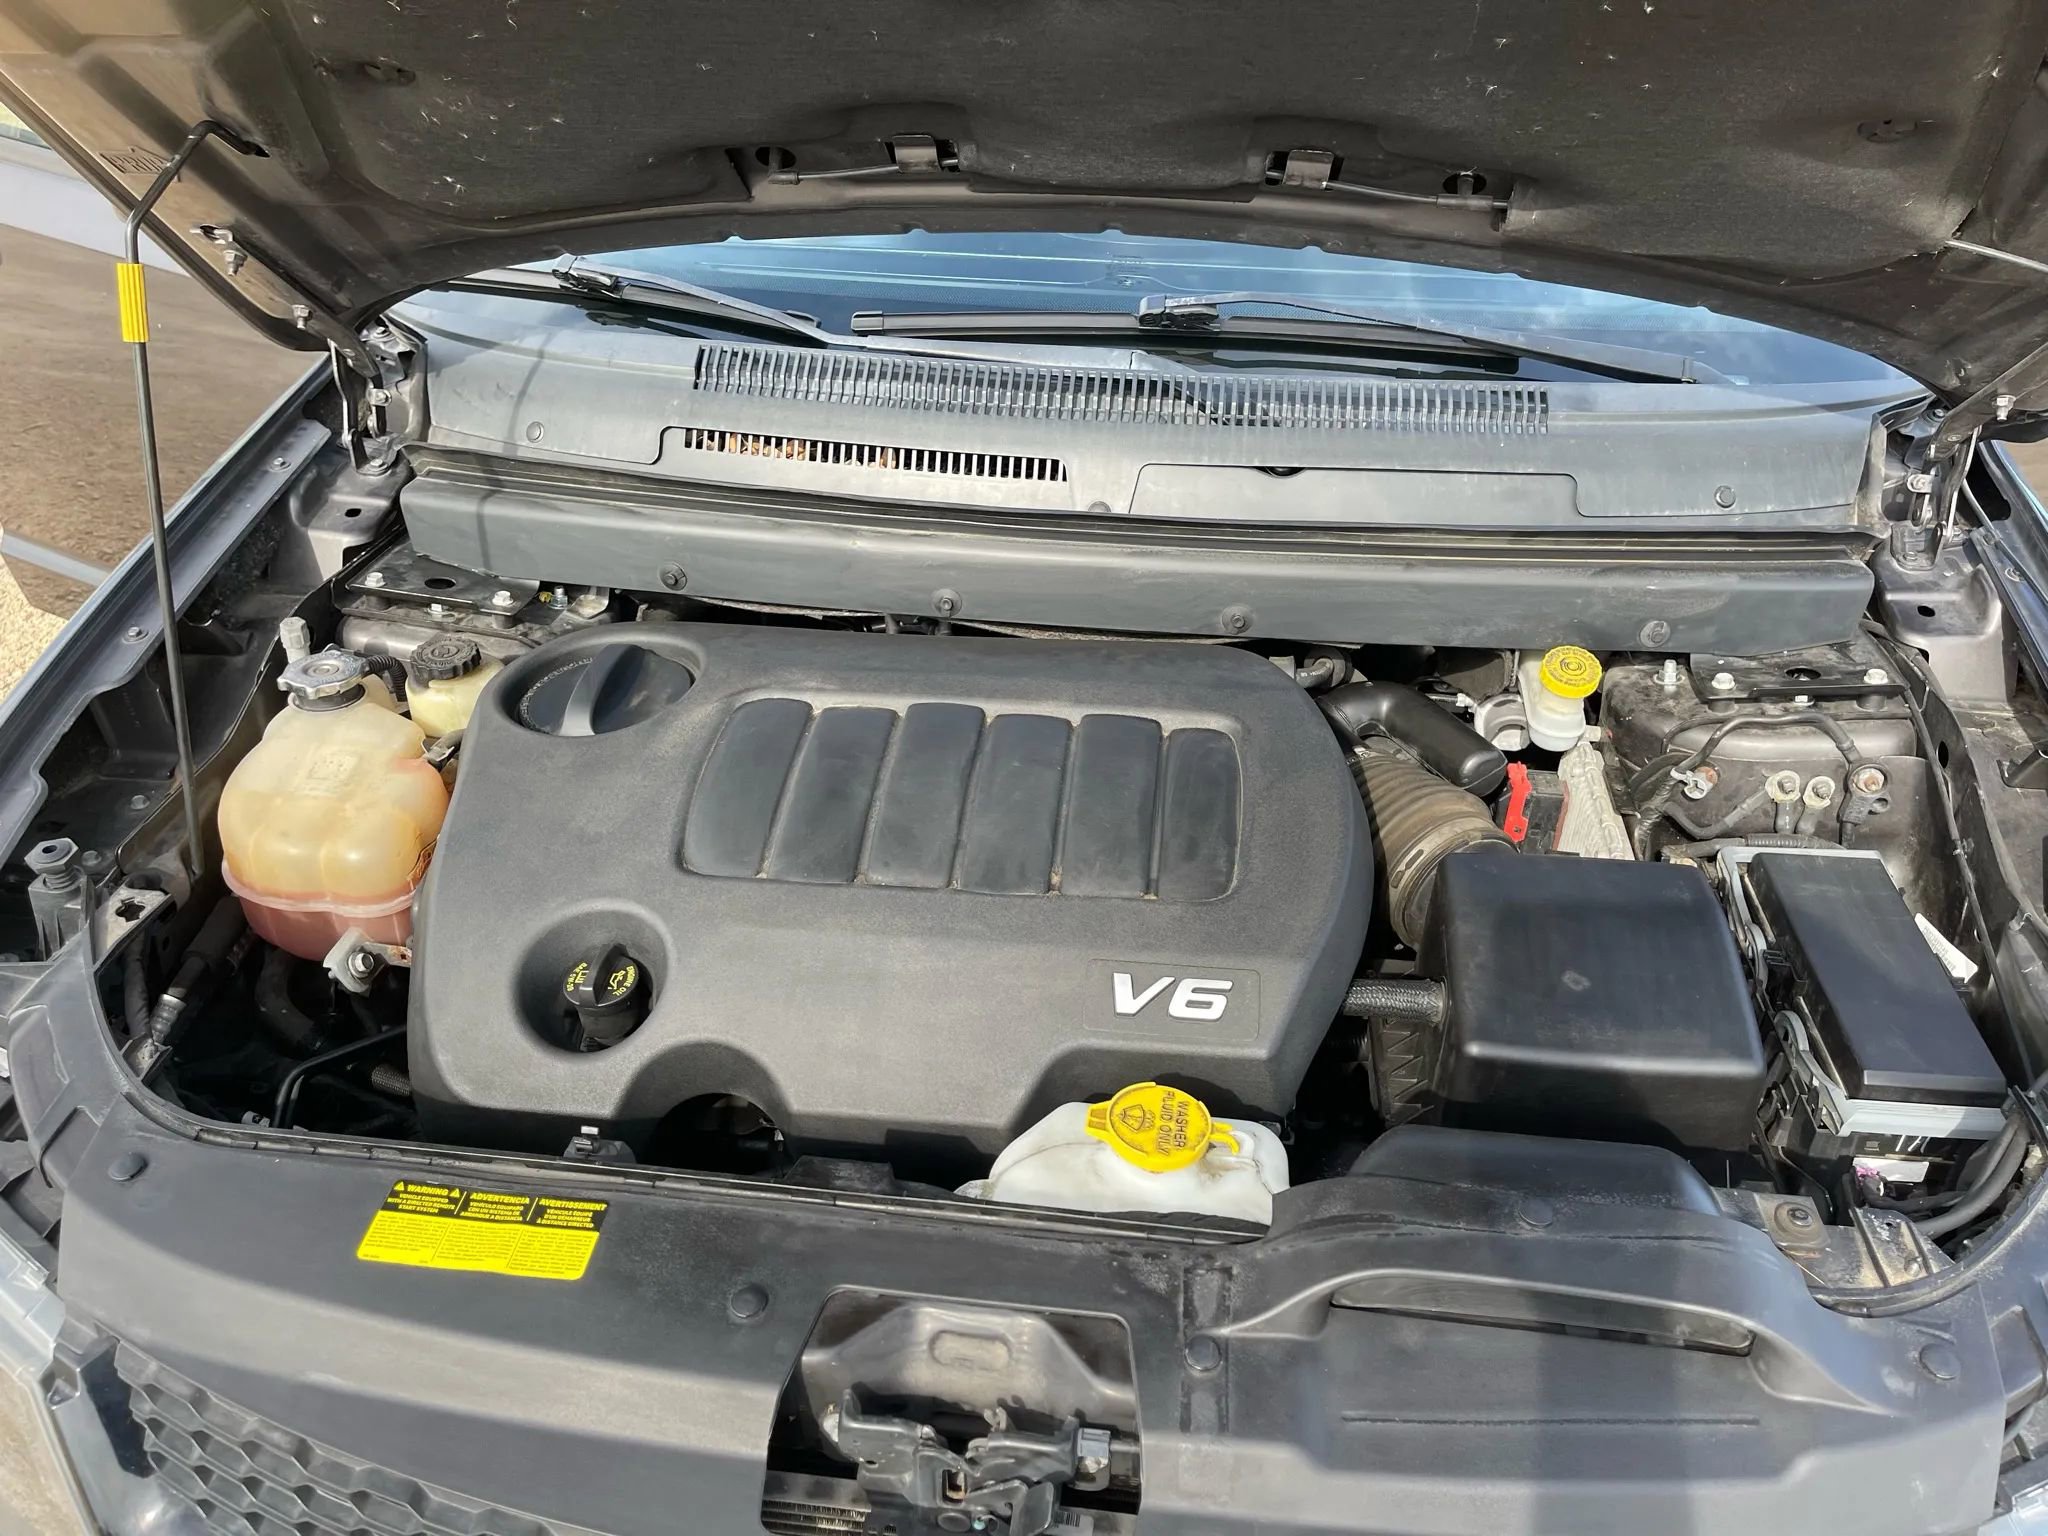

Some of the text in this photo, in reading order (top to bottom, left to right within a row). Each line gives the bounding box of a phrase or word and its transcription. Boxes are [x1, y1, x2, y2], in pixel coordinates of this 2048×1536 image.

[612, 986, 627, 996] OIL
[1112, 972, 1234, 1022] V6
[1157, 1090, 1176, 1157] FLUID ONLY
[1173, 1100, 1190, 1151] WASHER
[407, 1184, 449, 1196] WARNING
[470, 1192, 530, 1204] ADVERTENCIA
[539, 1198, 608, 1211] AVERTISSEMENT
